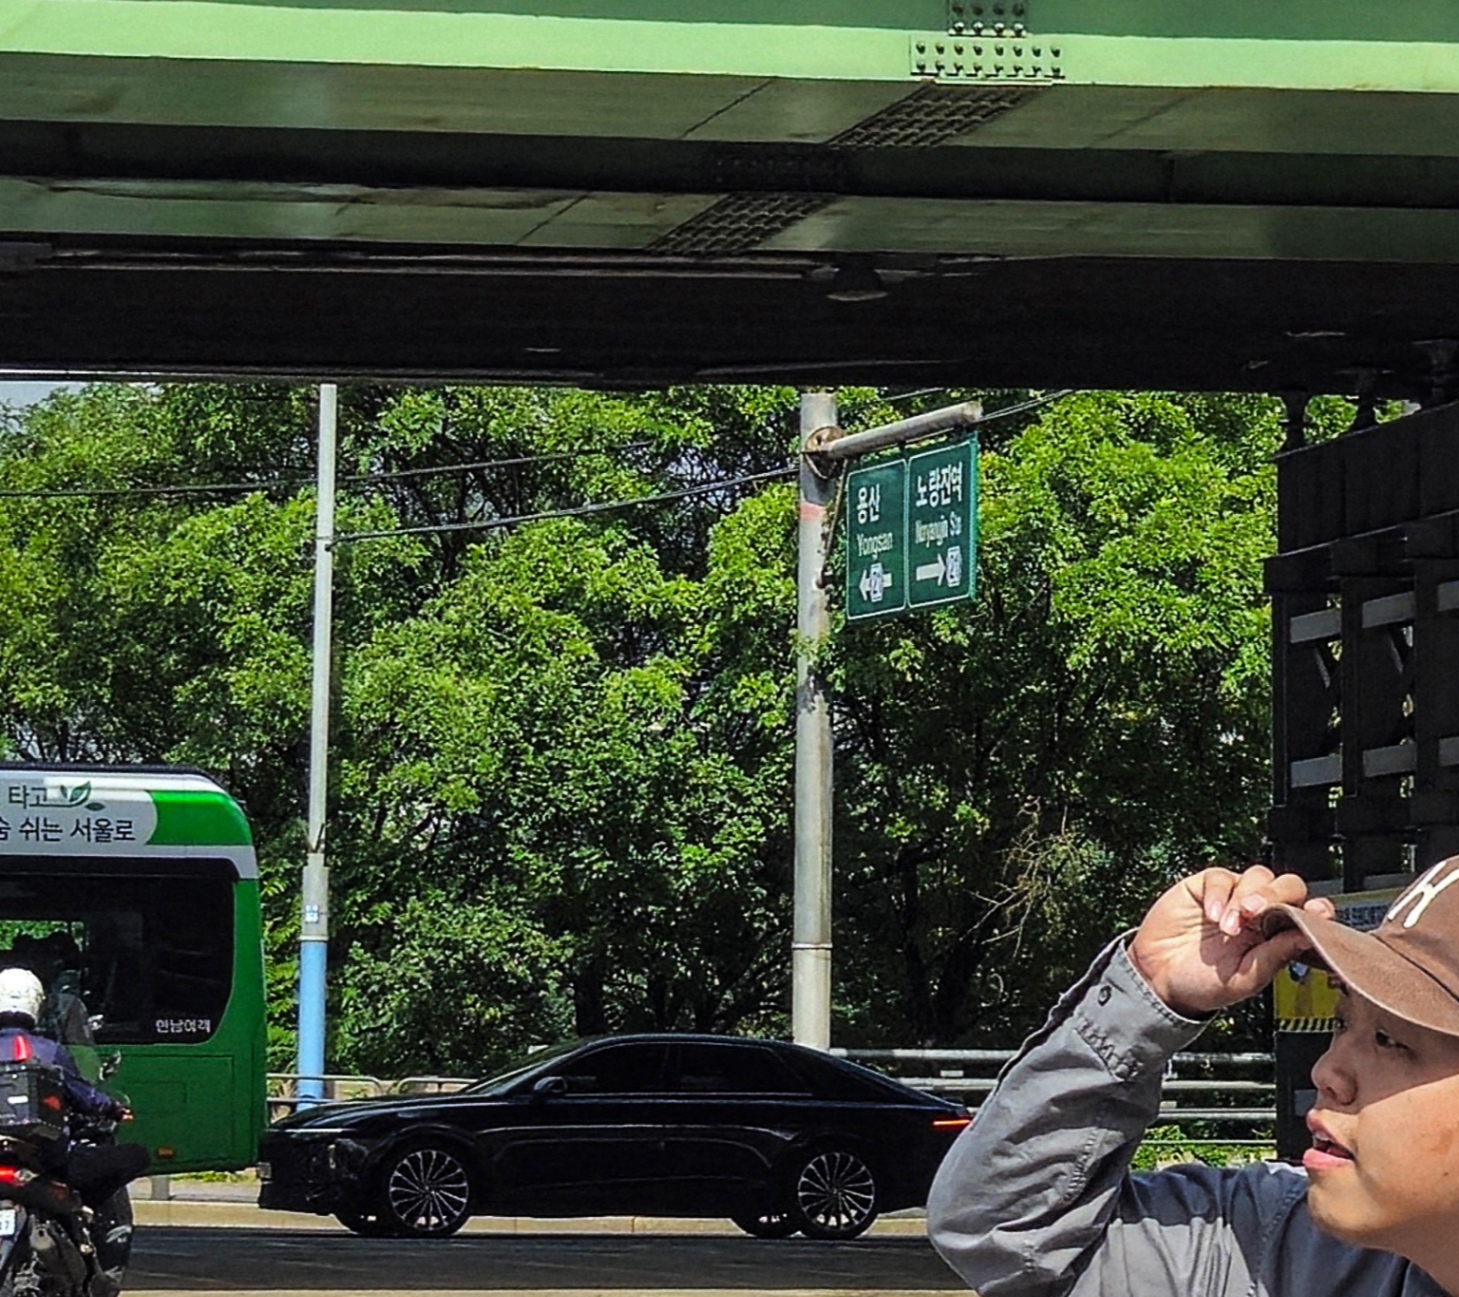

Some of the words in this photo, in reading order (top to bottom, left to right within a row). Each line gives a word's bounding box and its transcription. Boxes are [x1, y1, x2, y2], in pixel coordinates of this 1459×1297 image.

[857, 483, 880, 524] 용산
[8, 785, 47, 810] 타고
[19, 816, 63, 842] 쉬는
[70, 817, 136, 843] 서울로
